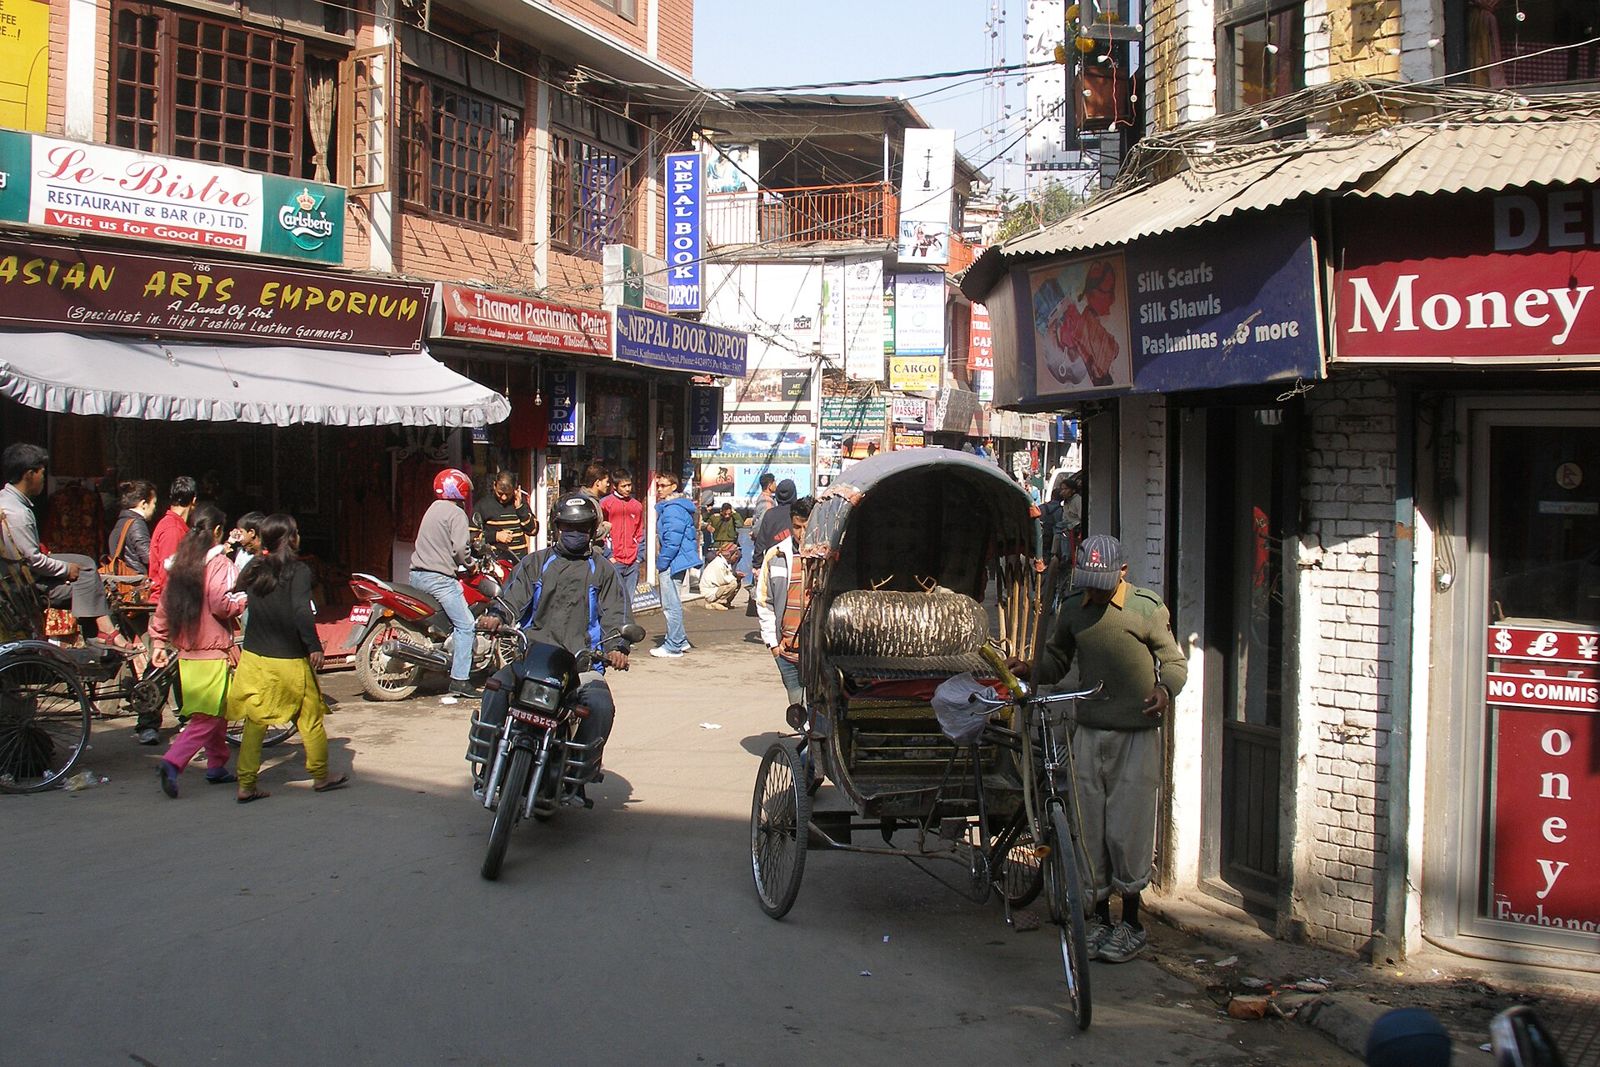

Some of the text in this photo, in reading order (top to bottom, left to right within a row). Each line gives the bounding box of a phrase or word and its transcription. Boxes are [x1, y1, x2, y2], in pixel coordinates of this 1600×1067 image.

[37, 146, 256, 207] Le-Bistro
[48, 190, 247, 230] RESTAURANT & BAR (P.) LTD.
[279, 205, 333, 236] Carlsberg
[673, 160, 694, 279] NEPAL BOOK
[1494, 190, 1600, 250] DE
[53, 212, 243, 247] Visit us for Good Food
[193, 263, 210, 272] 786
[1137, 262, 1213, 293] Silk Scarfs
[0, 255, 418, 321] ASIAN ARTS EMPORIUM
[668, 285, 699, 305] DEPOT
[67, 306, 354, 341] (Specialist in: High Fashion Leather Garments)
[167, 300, 273, 320] A Land Of Art
[474, 293, 522, 324] Thamel
[581, 310, 608, 335] Point
[1140, 294, 1221, 325] Silk Shawls
[1348, 274, 1594, 345] Money
[627, 314, 747, 361] NEPAL BOOK DEPOT
[1142, 329, 1218, 355] Pashminas
[1255, 320, 1299, 343] more
[893, 364, 936, 373] CARGO
[552, 374, 568, 418] USED
[723, 412, 760, 423] Education
[1494, 629, 1512, 653] $
[1489, 680, 1599, 703] NO COMMIS
